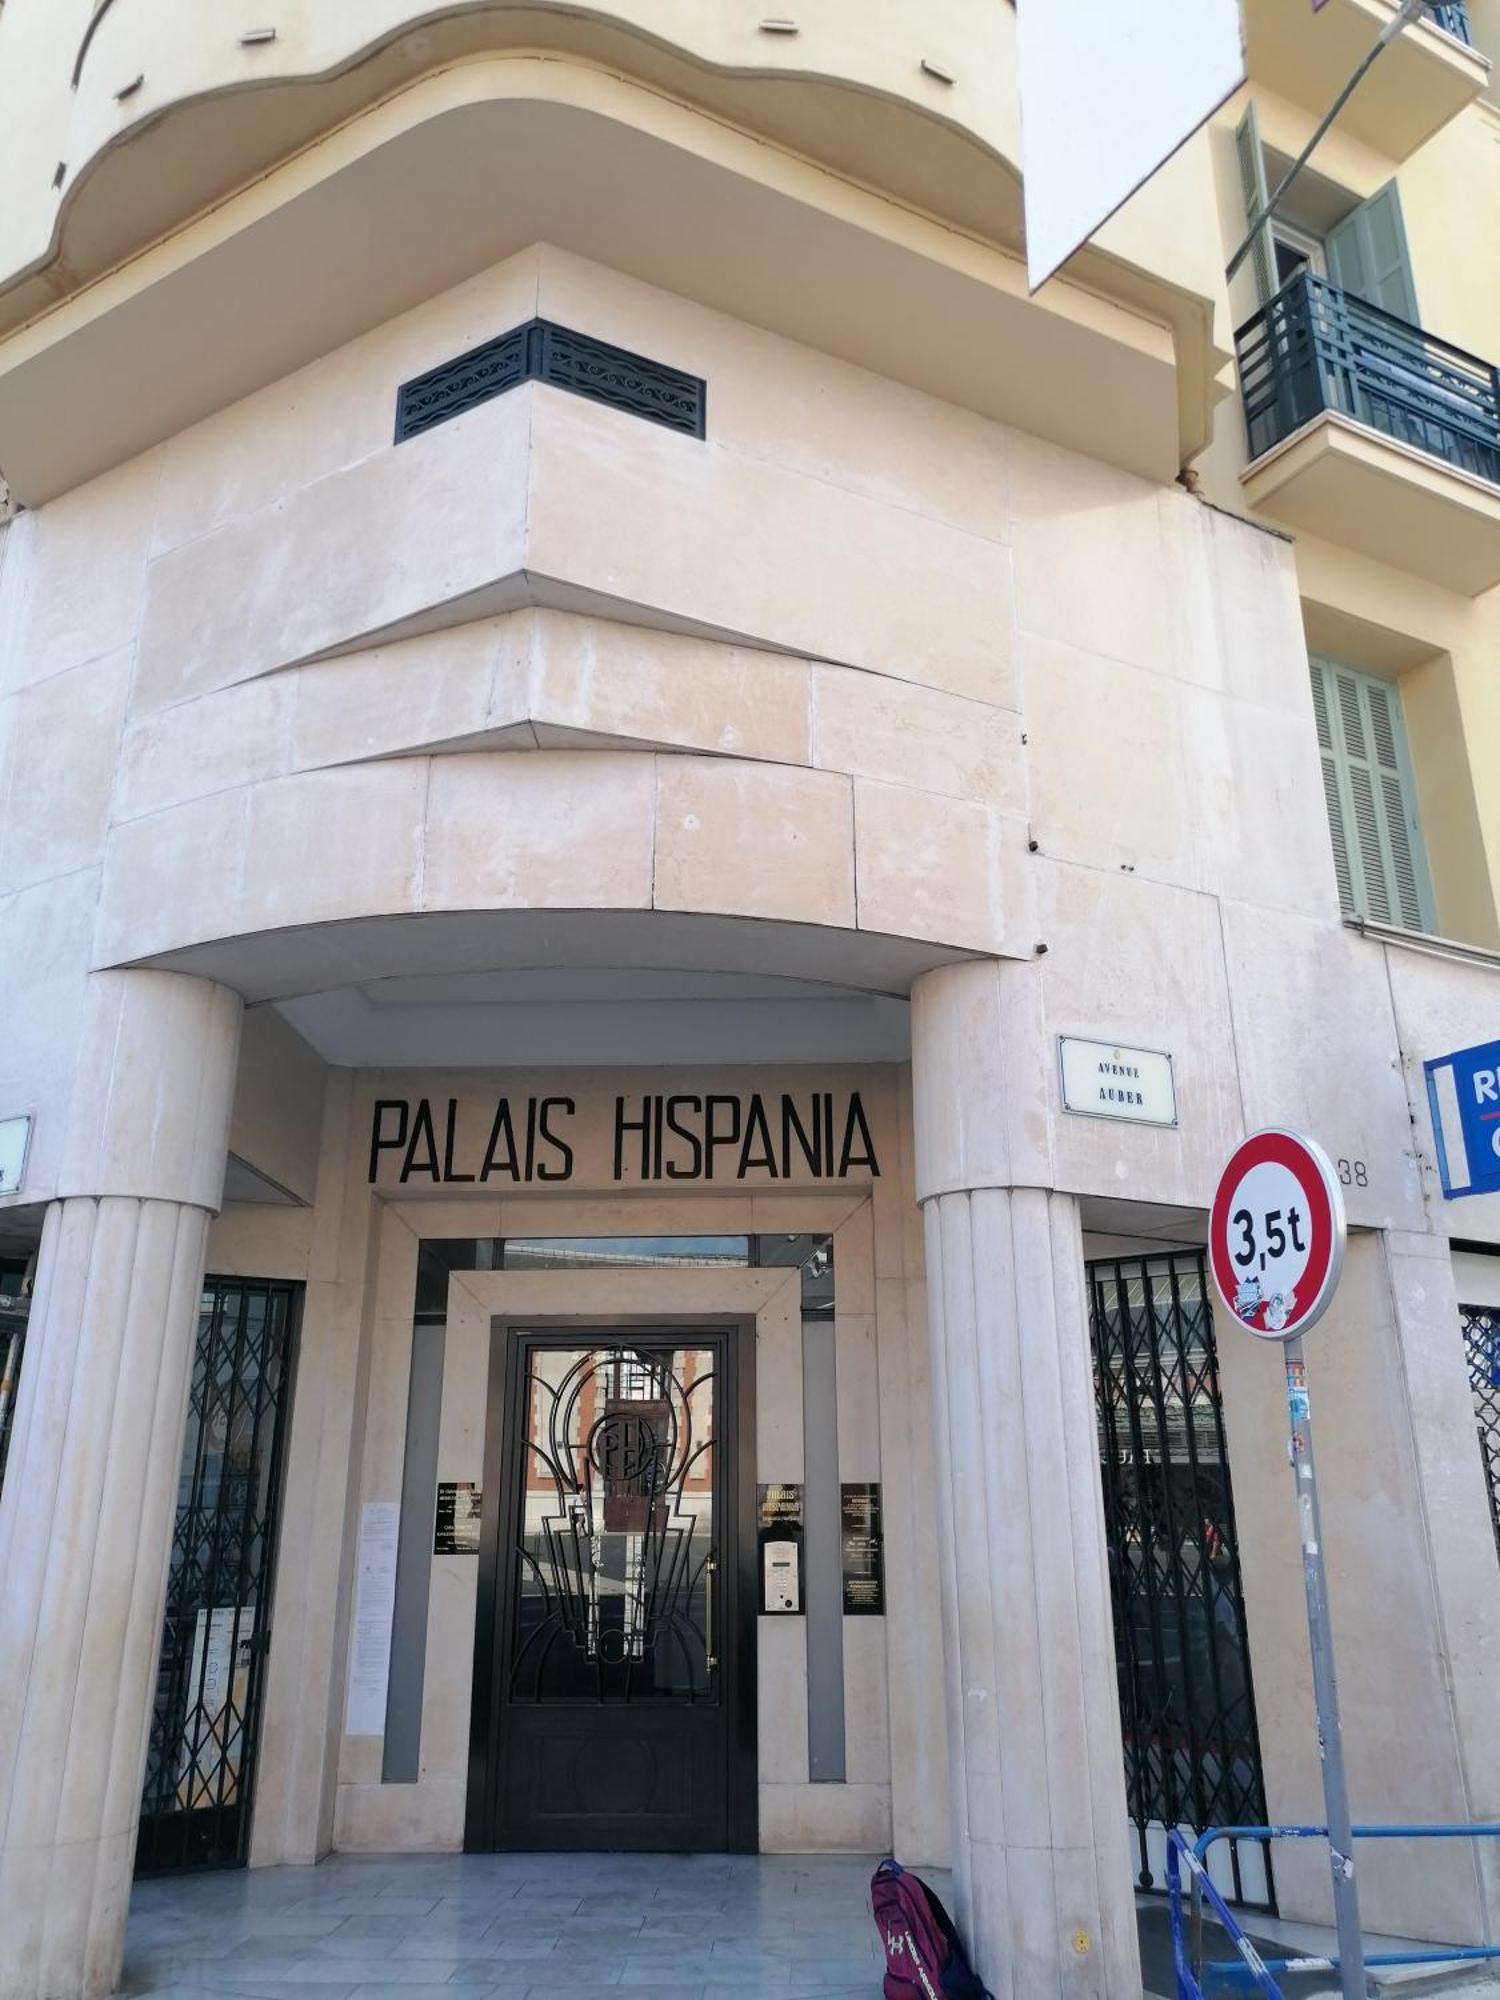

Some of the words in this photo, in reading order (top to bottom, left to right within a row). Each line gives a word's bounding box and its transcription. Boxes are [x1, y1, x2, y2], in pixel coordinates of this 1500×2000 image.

[1098, 1063, 1140, 1079] AVENUE
[1473, 1067, 1500, 1104] R
[1099, 1087, 1144, 1105] AUBER
[368, 1097, 575, 1183] PALAIS
[613, 1091, 881, 1180] HISPANIA
[1338, 1159, 1368, 1188] 38
[1233, 1207, 1306, 1271] 3,5t
